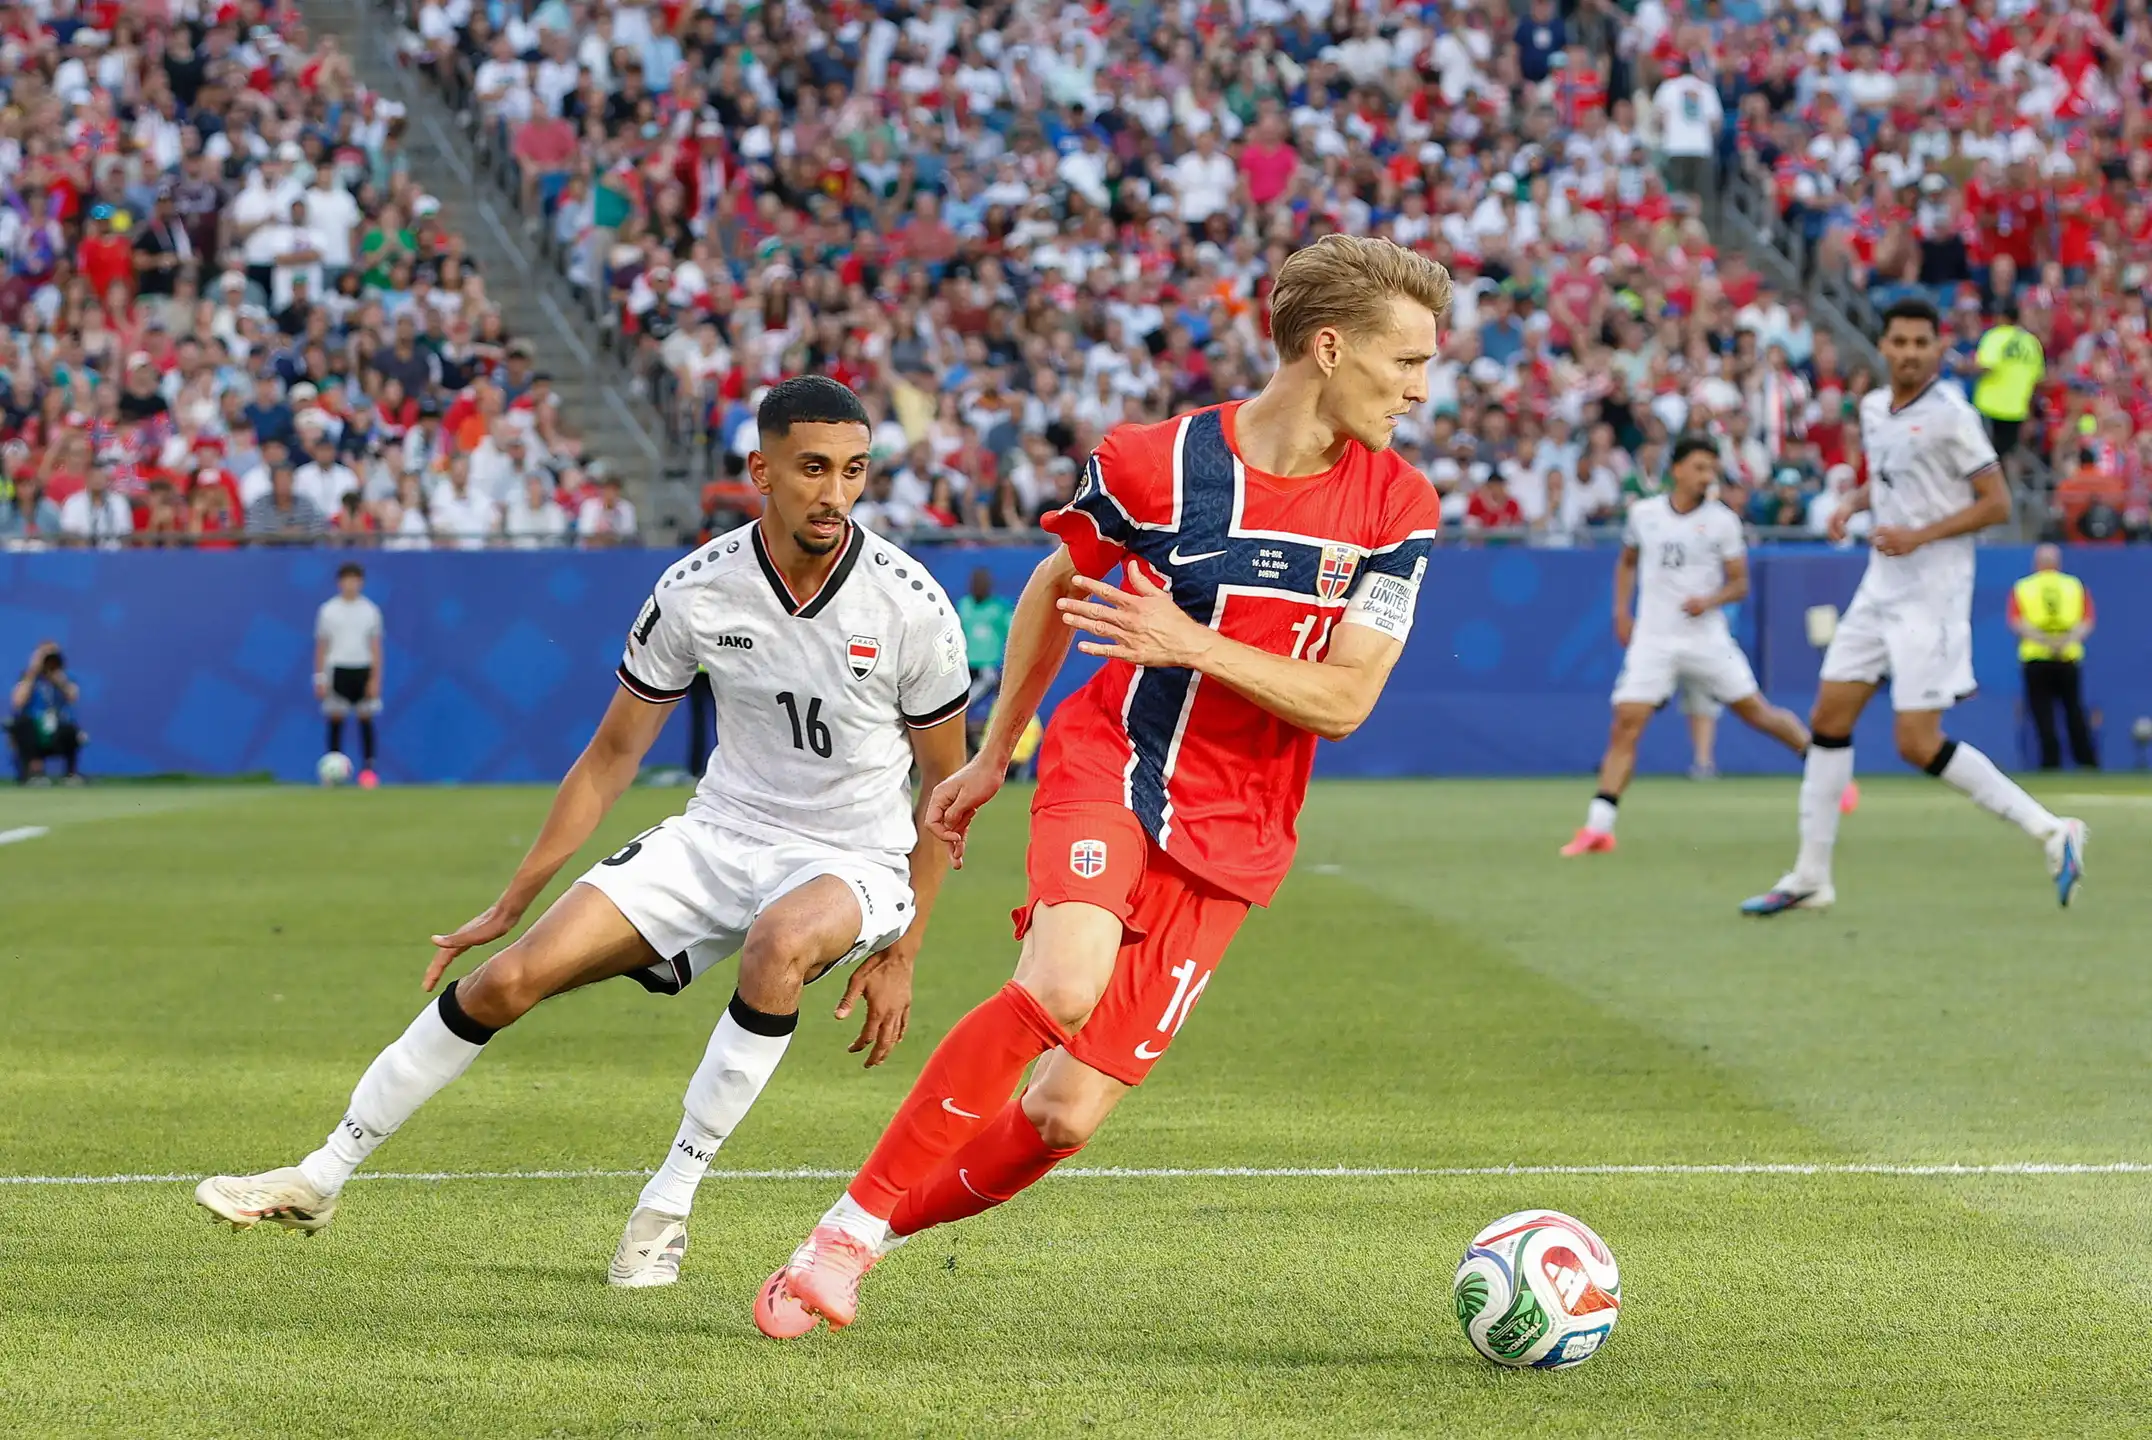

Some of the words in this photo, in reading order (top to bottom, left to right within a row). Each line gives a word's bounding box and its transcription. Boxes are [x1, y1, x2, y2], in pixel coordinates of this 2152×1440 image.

[1370, 586, 1408, 612] UNITES
[1376, 576, 1412, 599] FOOTBALL
[1362, 600, 1382, 613] the
[1383, 607, 1407, 625] World
[717, 635, 753, 650] JAKO
[776, 691, 832, 758] 16
[856, 879, 873, 915] JAKO
[677, 1139, 713, 1162] JAKO
[1505, 1322, 1543, 1353] TRIONDA
